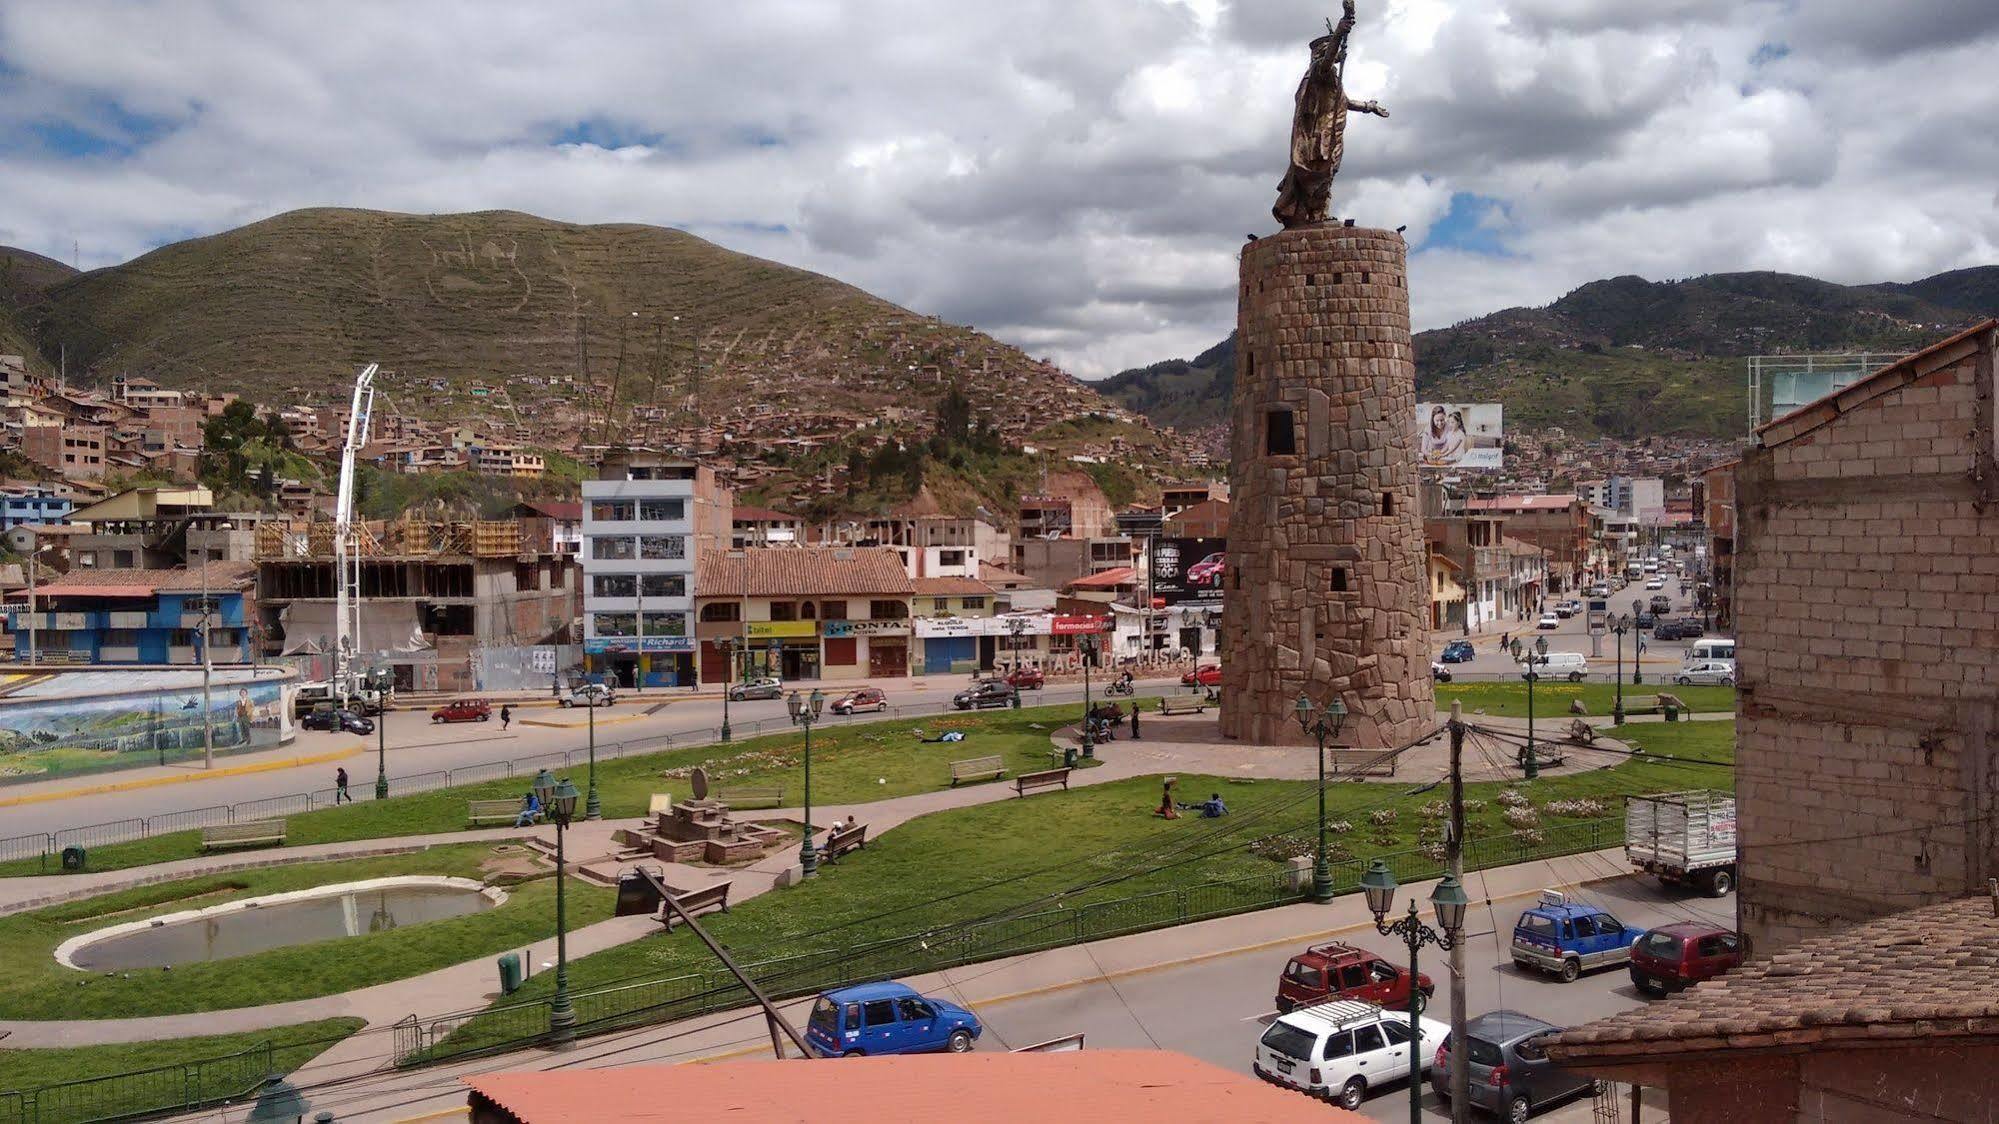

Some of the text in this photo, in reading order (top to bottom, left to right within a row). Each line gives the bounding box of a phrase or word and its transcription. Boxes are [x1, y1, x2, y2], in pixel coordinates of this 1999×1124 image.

[1155, 568, 1180, 578] BOCA
[1056, 622, 1094, 630] farmacias
[647, 638, 685, 646] Richard
[1102, 652, 1126, 670] DE
